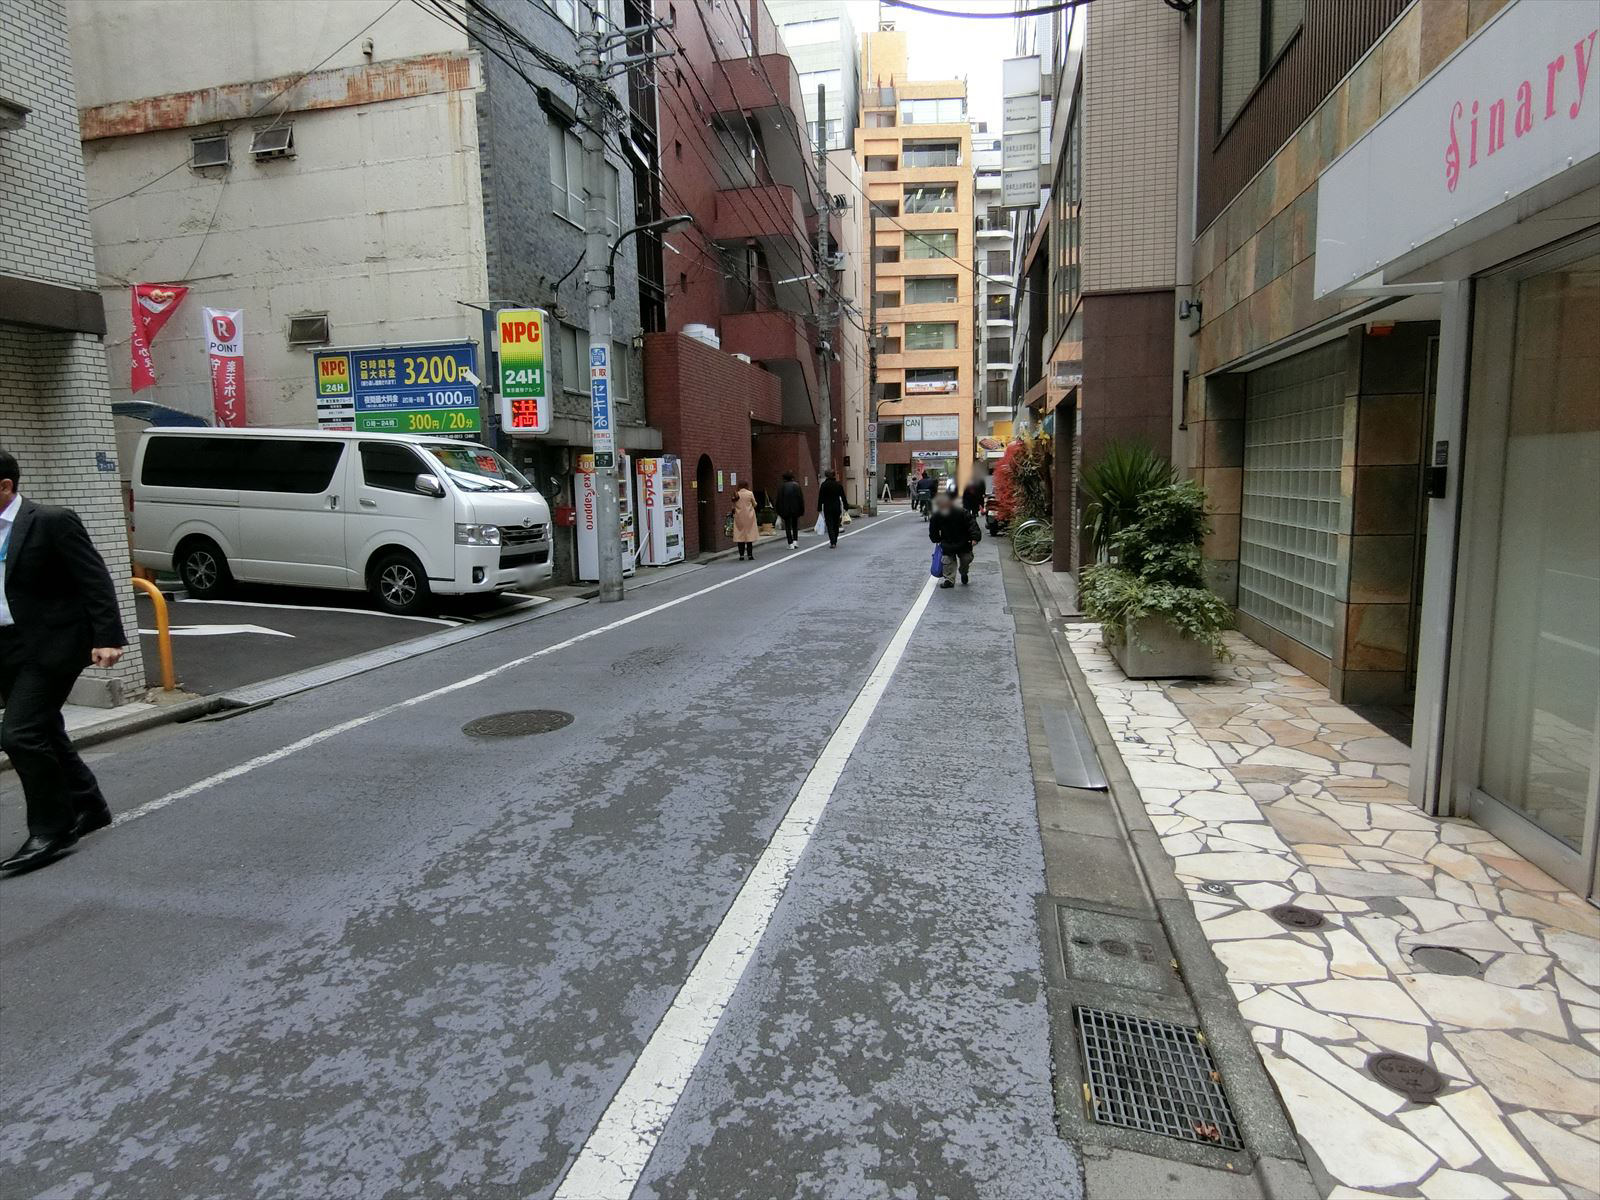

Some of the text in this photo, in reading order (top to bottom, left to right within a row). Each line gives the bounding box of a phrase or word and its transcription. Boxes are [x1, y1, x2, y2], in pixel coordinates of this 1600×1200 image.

[1445, 29, 1599, 193] Sinary
[501, 321, 540, 344] NPC
[209, 341, 238, 353] POINT
[320, 360, 346, 376] NPC
[505, 369, 541, 385] 24H
[325, 383, 344, 392] 24H
[426, 391, 472, 406] 1000円
[592, 380, 608, 428] セキネ
[512, 400, 538, 428] 満
[905, 419, 921, 427] CAN
